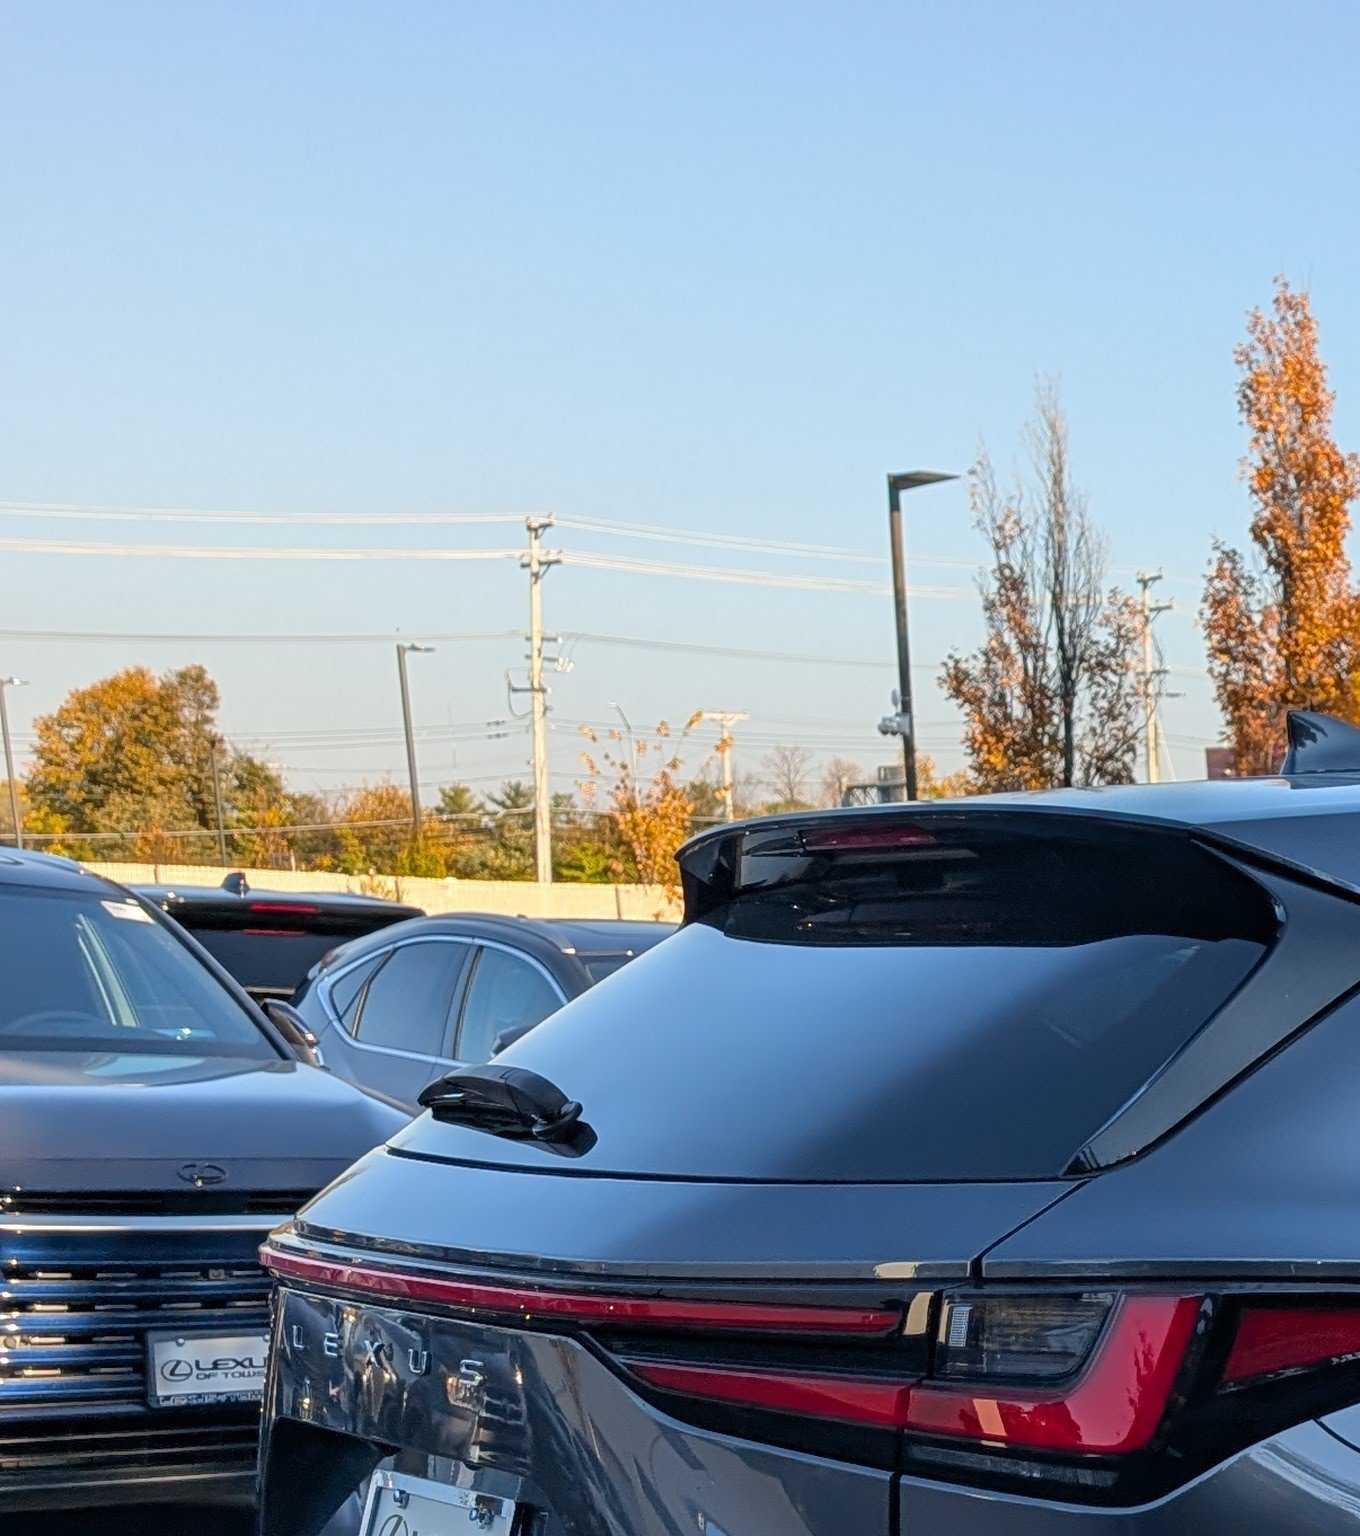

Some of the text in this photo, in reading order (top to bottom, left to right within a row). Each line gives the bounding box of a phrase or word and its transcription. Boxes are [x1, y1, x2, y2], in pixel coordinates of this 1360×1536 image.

[292, 1323, 485, 1387] LEXUS
[194, 1356, 268, 1371] LEXU
[195, 1370, 218, 1381] OF
